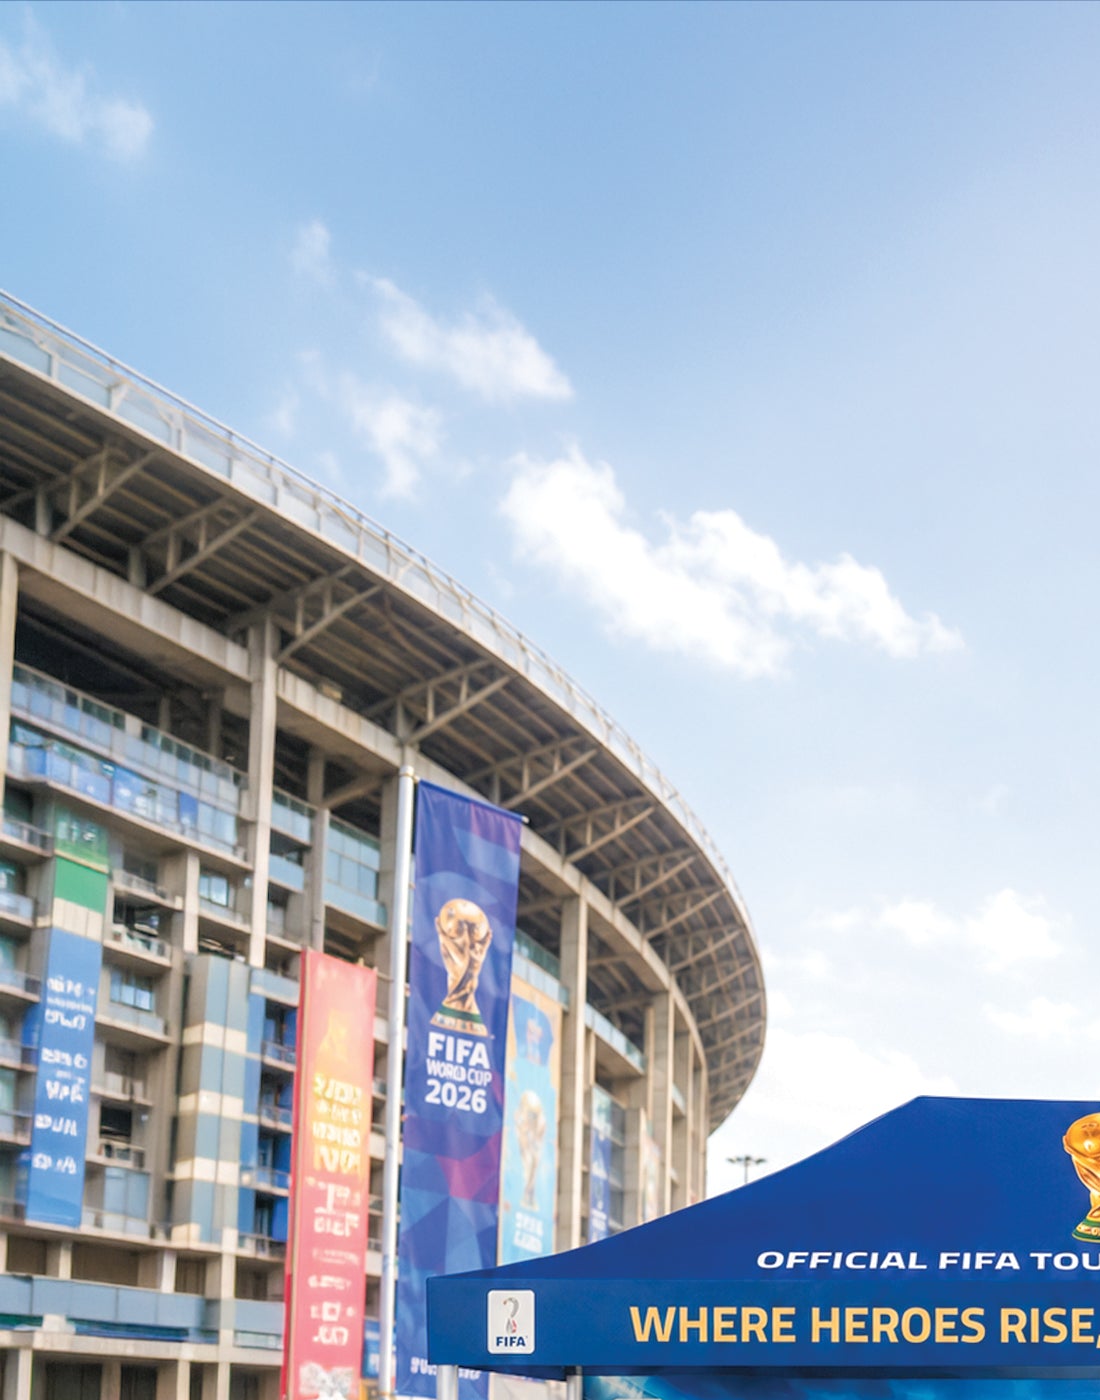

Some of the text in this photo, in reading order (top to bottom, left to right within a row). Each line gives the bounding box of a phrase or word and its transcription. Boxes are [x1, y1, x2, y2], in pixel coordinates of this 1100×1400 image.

[427, 1031, 491, 1070] FIFA
[466, 1067, 493, 1086] CUP
[424, 1078, 487, 1114] 2026
[757, 1251, 928, 1270] OFFICIAL
[938, 1252, 1021, 1270] FIFA
[629, 1306, 796, 1343] WHERE
[811, 1306, 986, 1344] HEROES
[496, 1335, 526, 1347] FIFA
